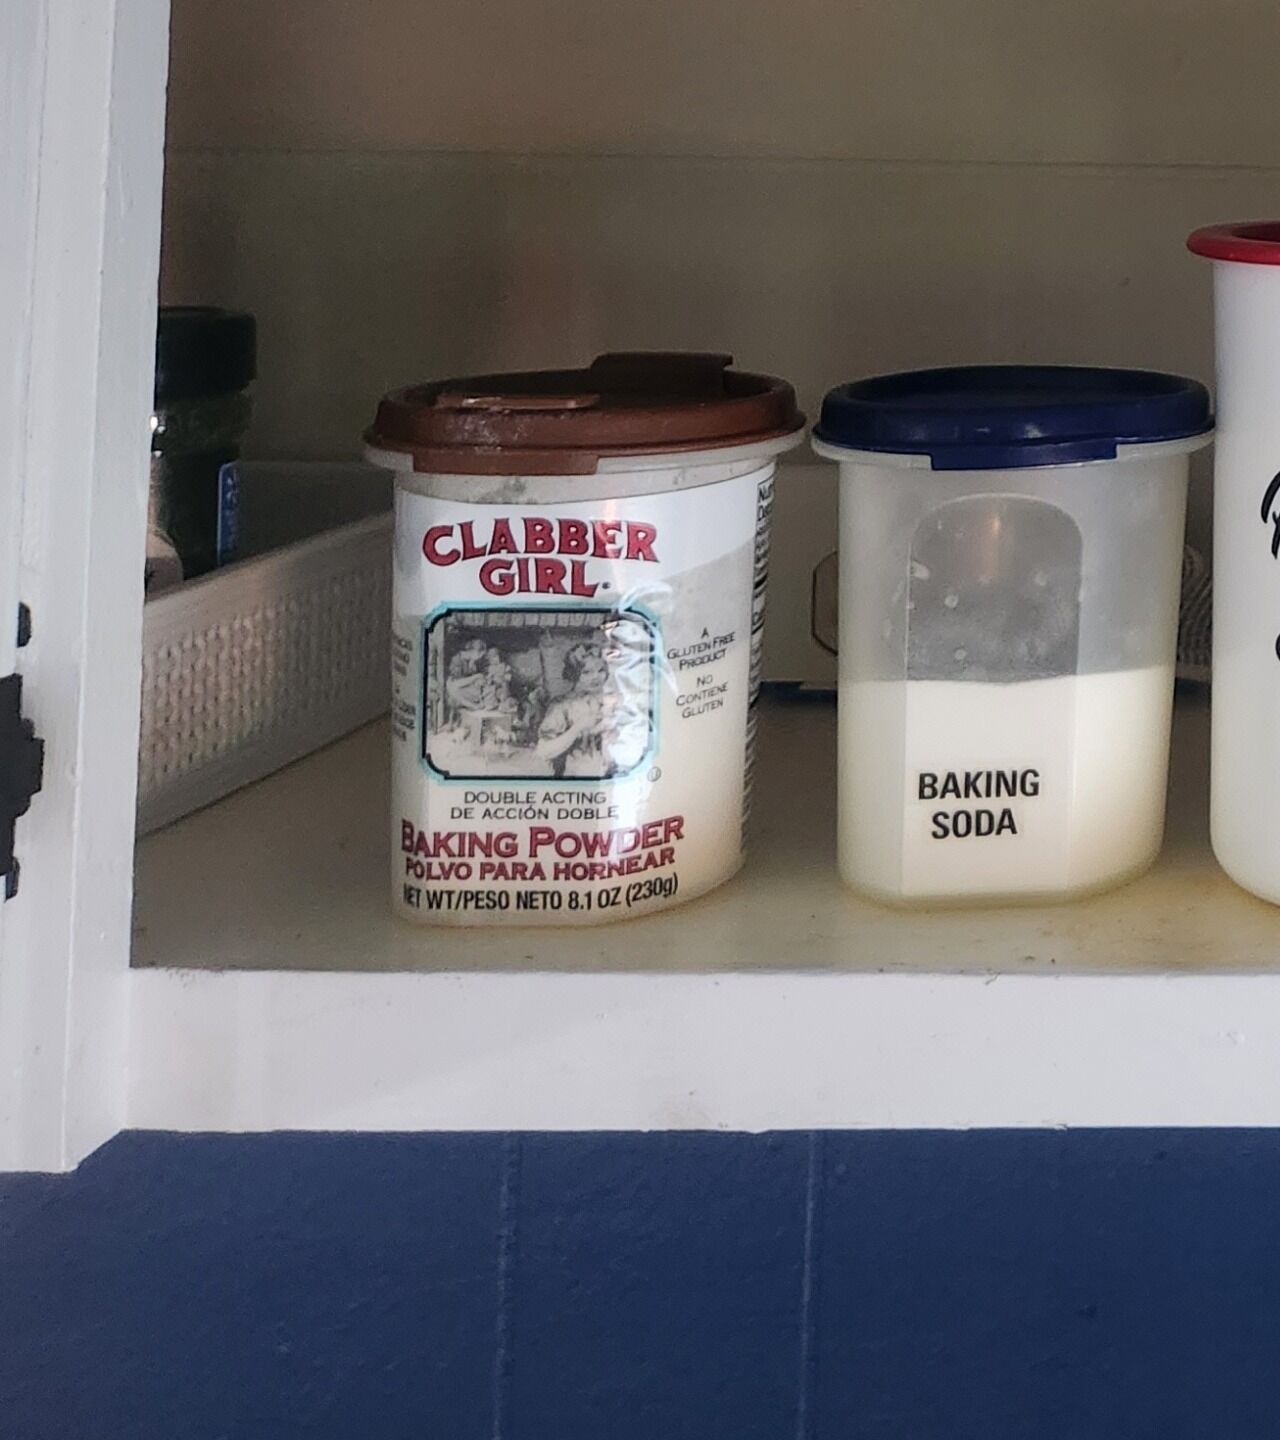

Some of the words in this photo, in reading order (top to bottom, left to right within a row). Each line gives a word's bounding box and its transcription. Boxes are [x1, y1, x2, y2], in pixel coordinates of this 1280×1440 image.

[422, 517, 660, 567] CLABBER
[479, 558, 599, 598] GIRL
[667, 642, 711, 660] GLUTEN
[713, 631, 735, 649] FREE
[701, 627, 709, 639] A
[679, 648, 726, 670] PRODUCT
[676, 681, 728, 707] CONTIENE
[697, 674, 713, 687] NO
[682, 697, 723, 719] GLUTEN
[464, 791, 536, 804] DOUBLE
[542, 791, 606, 804] ACTING
[918, 769, 1040, 801] BAKING
[450, 807, 474, 820] DE
[482, 805, 549, 820] ACCIÓN
[558, 807, 619, 820] DOBLE
[932, 809, 1017, 839] SODA
[401, 818, 518, 858] BAKING
[529, 815, 685, 858] POWDER
[405, 856, 472, 881] POLVO
[480, 862, 546, 881] PARA
[553, 846, 675, 881] HORNEAR
[427, 890, 509, 910] WT/PESO
[516, 890, 562, 911] NETO
[568, 891, 592, 910] 8.1
[598, 886, 621, 908] OZ
[625, 872, 679, 907] (230g)
